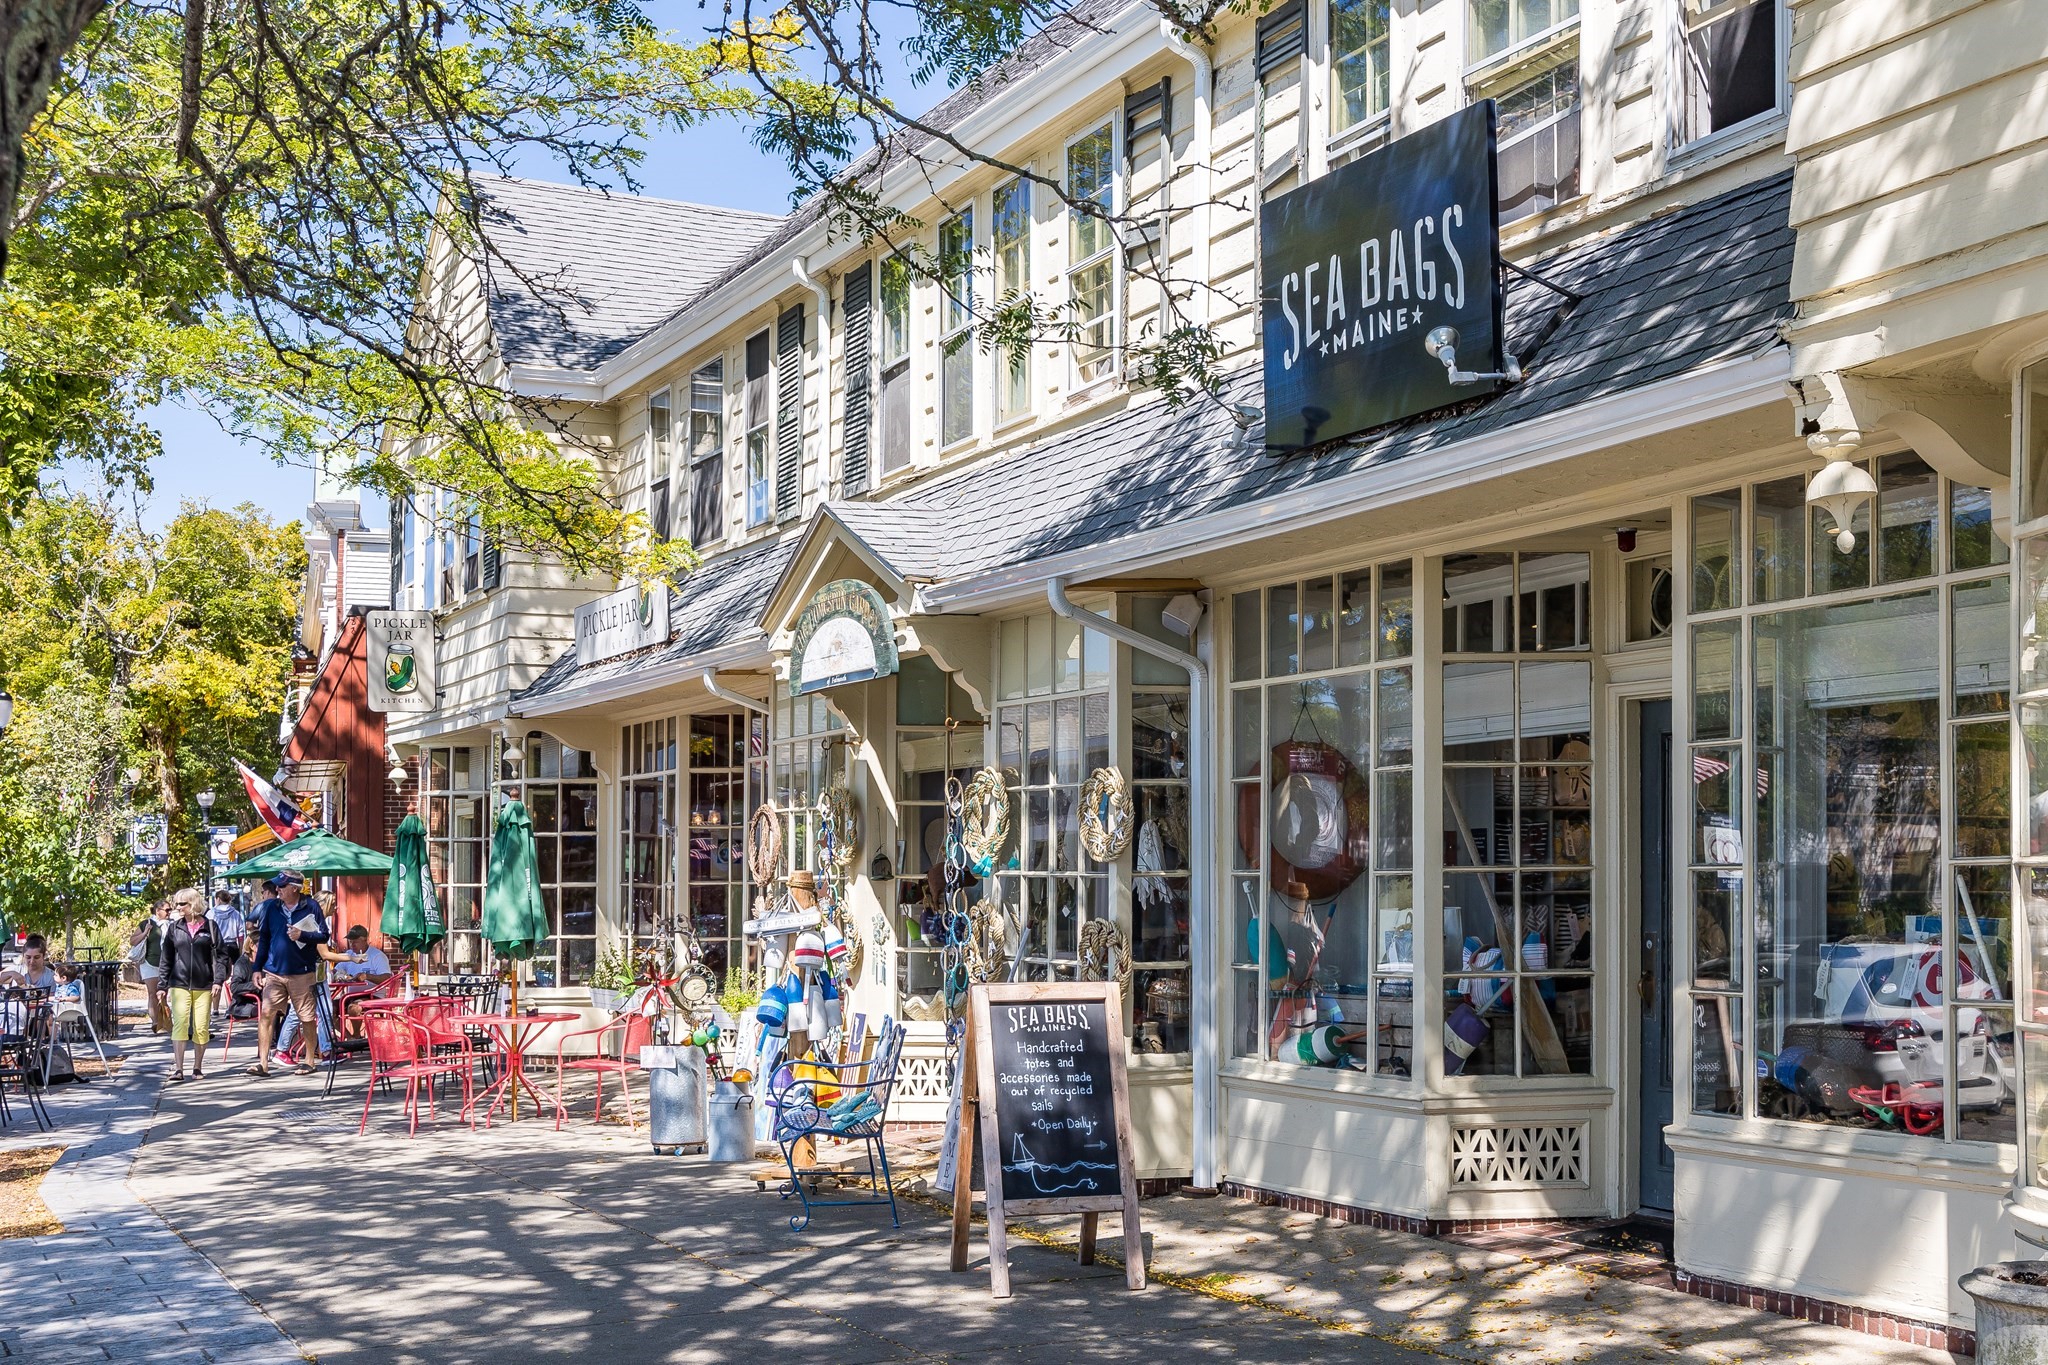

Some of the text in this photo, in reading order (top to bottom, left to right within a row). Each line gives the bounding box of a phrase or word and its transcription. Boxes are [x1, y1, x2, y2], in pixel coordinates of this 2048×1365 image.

[1281, 204, 1464, 371] SEA BAGS
[1333, 308, 1407, 354] MAINE
[374, 618, 427, 629] PICKLE
[583, 598, 639, 637] PICKLE JAR
[387, 630, 414, 642] JAR
[1008, 1004, 1089, 1034] SEA BAGS
[1033, 1024, 1066, 1033] MAINE
[1017, 1040, 1084, 1053] Handcrafted
[1024, 1057, 1074, 1070] totes and
[999, 1072, 1092, 1084] accessories made
[1011, 1084, 1093, 1101] out of recycled
[1031, 1099, 1054, 1112] sails
[1037, 1116, 1092, 1136] Open Daily
